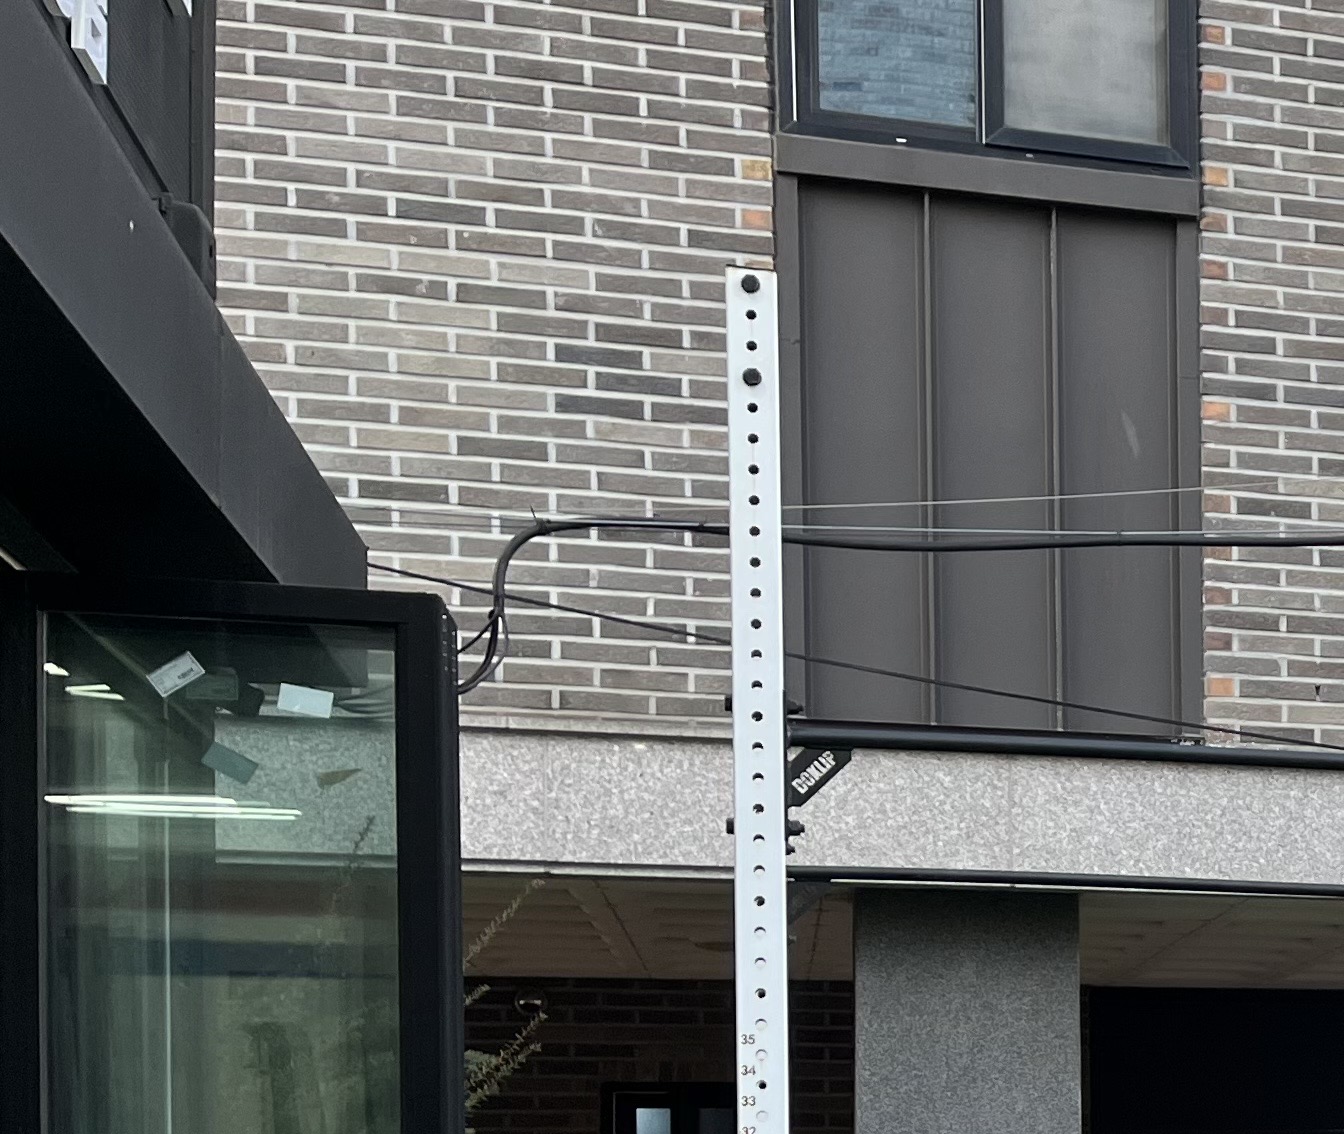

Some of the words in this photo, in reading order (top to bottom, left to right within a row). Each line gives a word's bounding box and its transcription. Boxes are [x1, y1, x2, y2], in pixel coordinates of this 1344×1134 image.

[740, 1034, 756, 1044] 35
[741, 1064, 756, 1076] 34
[742, 1096, 756, 1106] 33
